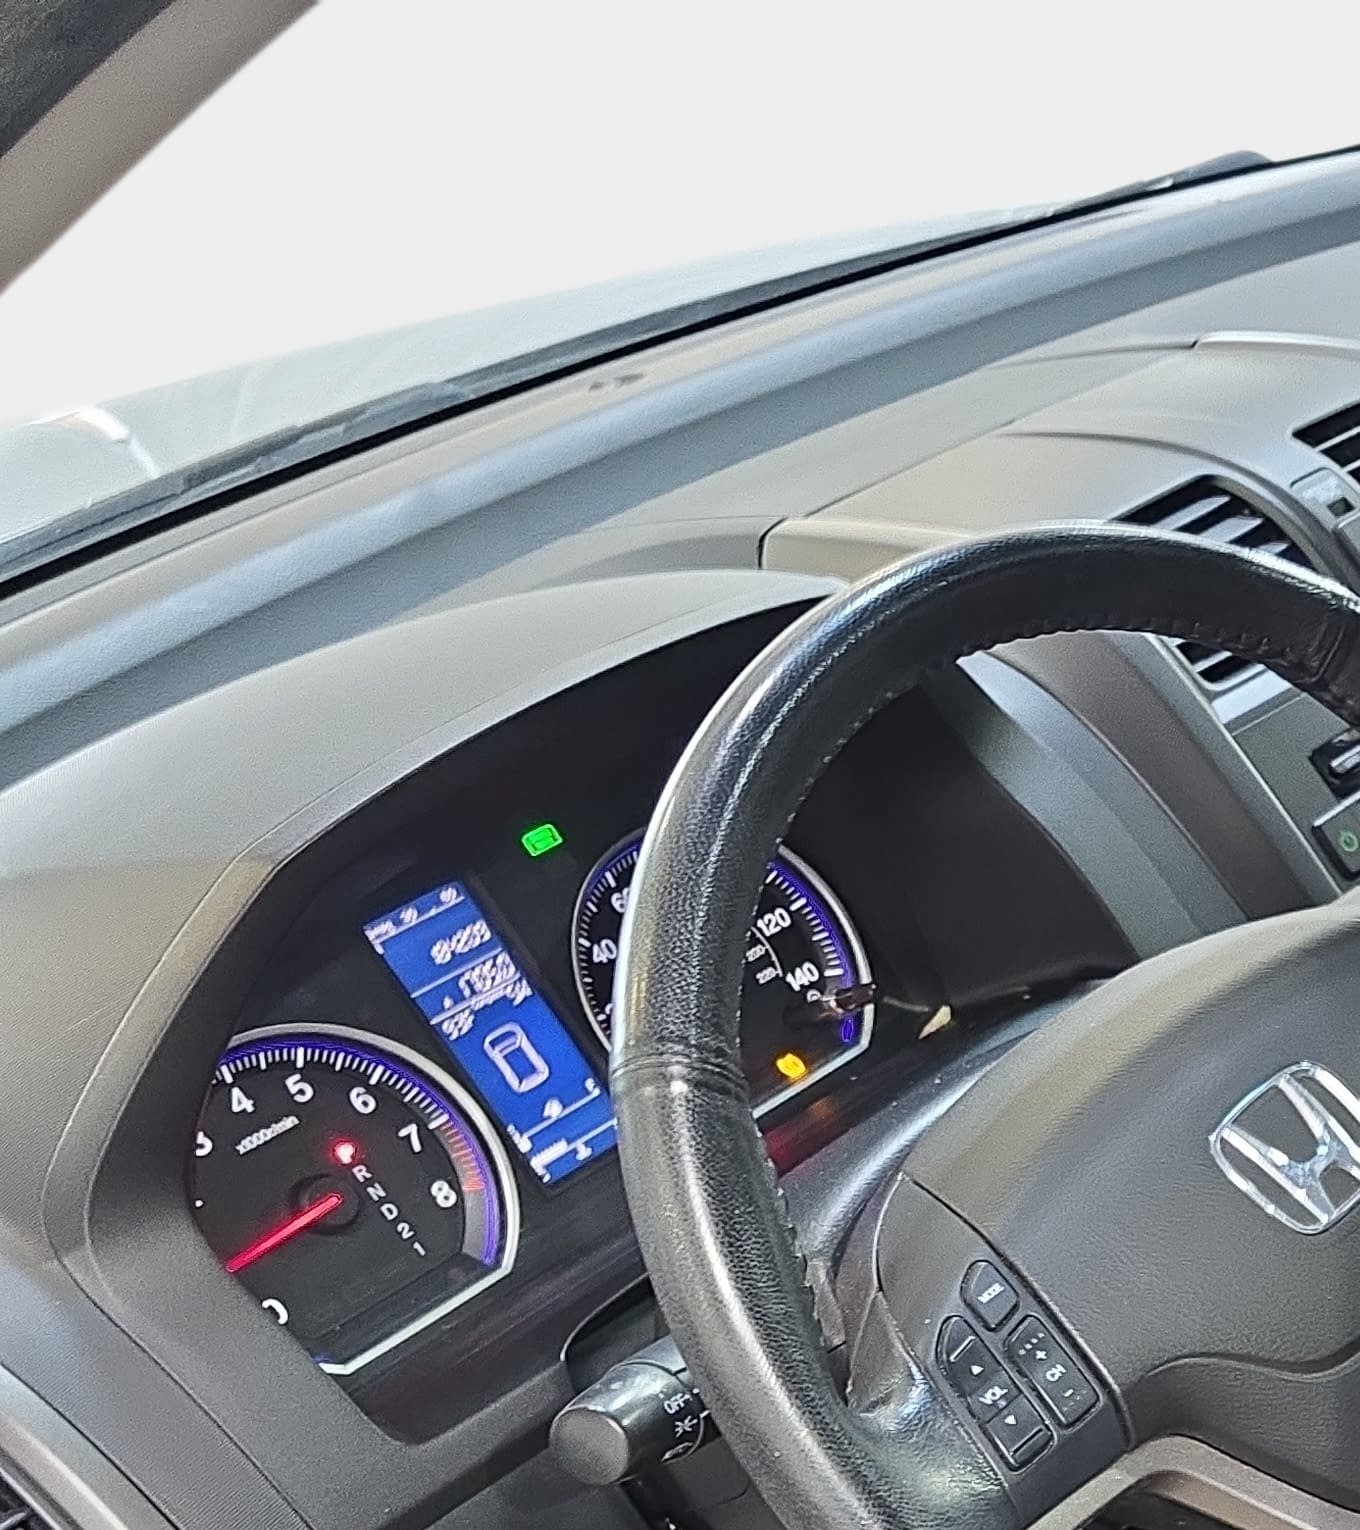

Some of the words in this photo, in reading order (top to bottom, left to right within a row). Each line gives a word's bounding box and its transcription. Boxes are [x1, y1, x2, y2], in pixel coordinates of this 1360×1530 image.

[756, 906, 792, 937] 120
[591, 938, 618, 965] 40
[785, 961, 820, 992] 140
[230, 1086, 256, 1114] 4
[284, 1073, 315, 1103] 5
[348, 1086, 377, 1115] 6
[397, 1123, 423, 1153] 7
[430, 1180, 458, 1209] 8
[351, 1164, 373, 1183] R
[366, 1182, 387, 1202] N
[379, 1202, 399, 1221] D
[396, 1222, 415, 1240] 2
[412, 1242, 427, 1257] 1
[1045, 1363, 1068, 1383] CH
[663, 1392, 692, 1415] OFF
[978, 1385, 1009, 1406] VOL
